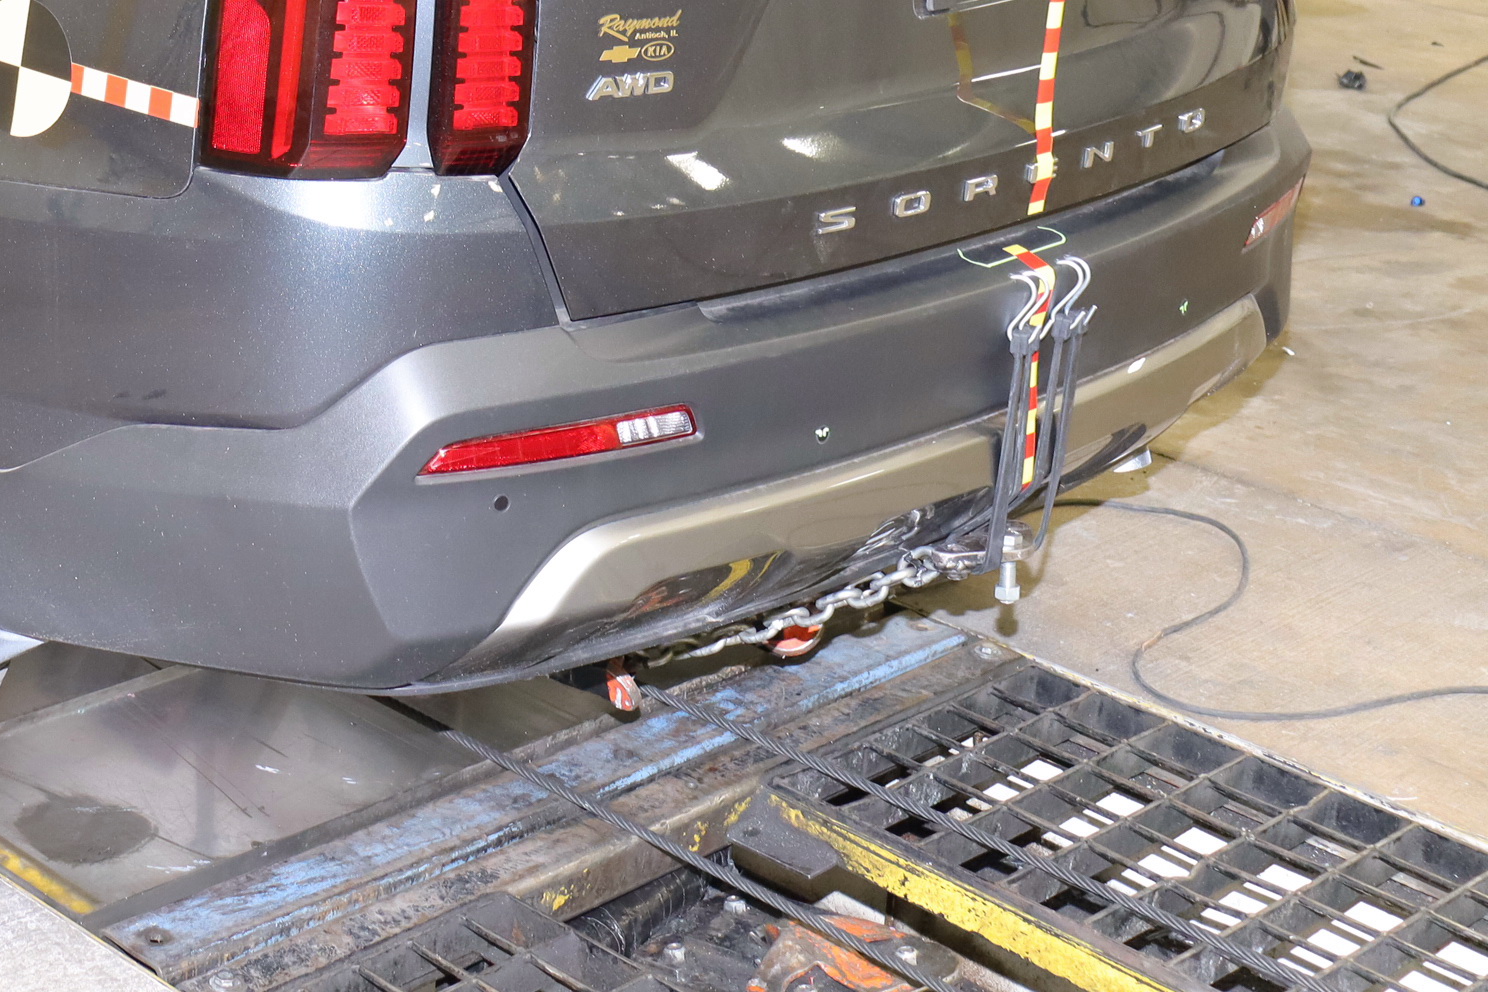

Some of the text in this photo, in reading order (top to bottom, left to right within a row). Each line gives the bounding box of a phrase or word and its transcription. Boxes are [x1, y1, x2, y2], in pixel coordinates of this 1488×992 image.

[597, 9, 683, 42] Raymond
[634, 31, 668, 41] Antioch,
[646, 44, 669, 57] KIA
[585, 70, 675, 101] AWD
